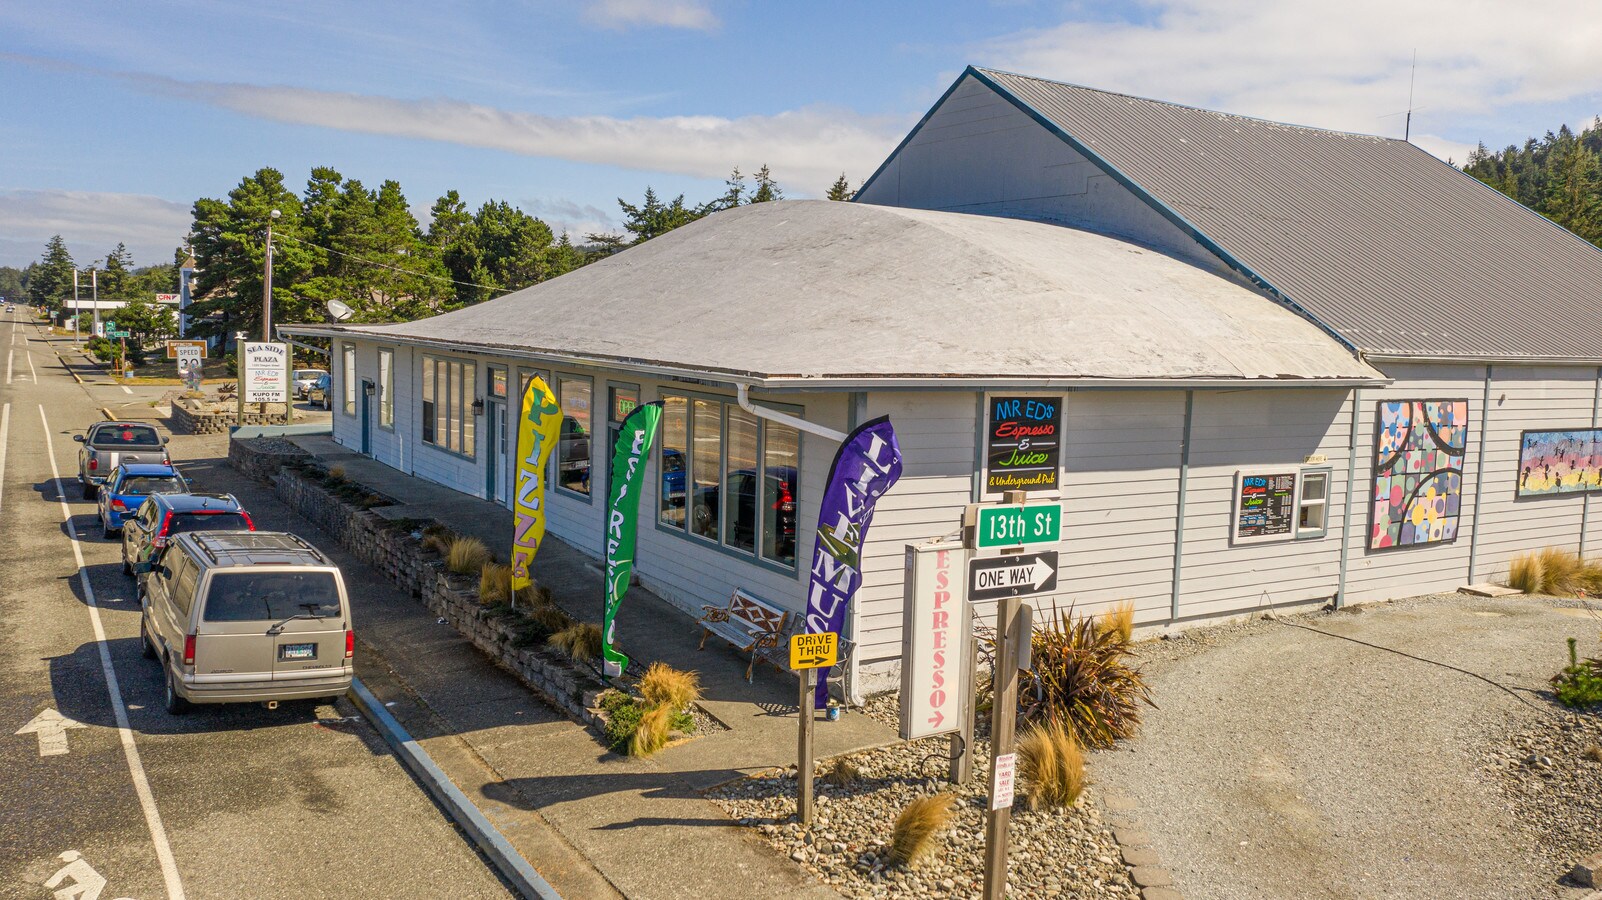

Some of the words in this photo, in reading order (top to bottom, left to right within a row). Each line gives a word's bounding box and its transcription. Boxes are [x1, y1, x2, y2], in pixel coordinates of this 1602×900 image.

[247, 345, 263, 355] SEA
[264, 345, 285, 356] SIDE
[996, 399, 1022, 421] MR
[995, 421, 1055, 440] Espresso
[1018, 438, 1030, 450] &
[998, 448, 1049, 466] Juice
[989, 476, 995, 486] &
[995, 472, 1041, 489] Underground
[1041, 471, 1055, 485] Pub
[1244, 477, 1255, 487] MR
[829, 431, 891, 554] LIVE
[990, 514, 1026, 540] 13th
[1033, 512, 1052, 537] St
[978, 570, 1005, 588] ONE
[1009, 566, 1035, 585] WAY
[929, 550, 951, 709] ESPRESSO
[798, 645, 830, 657] THRU
